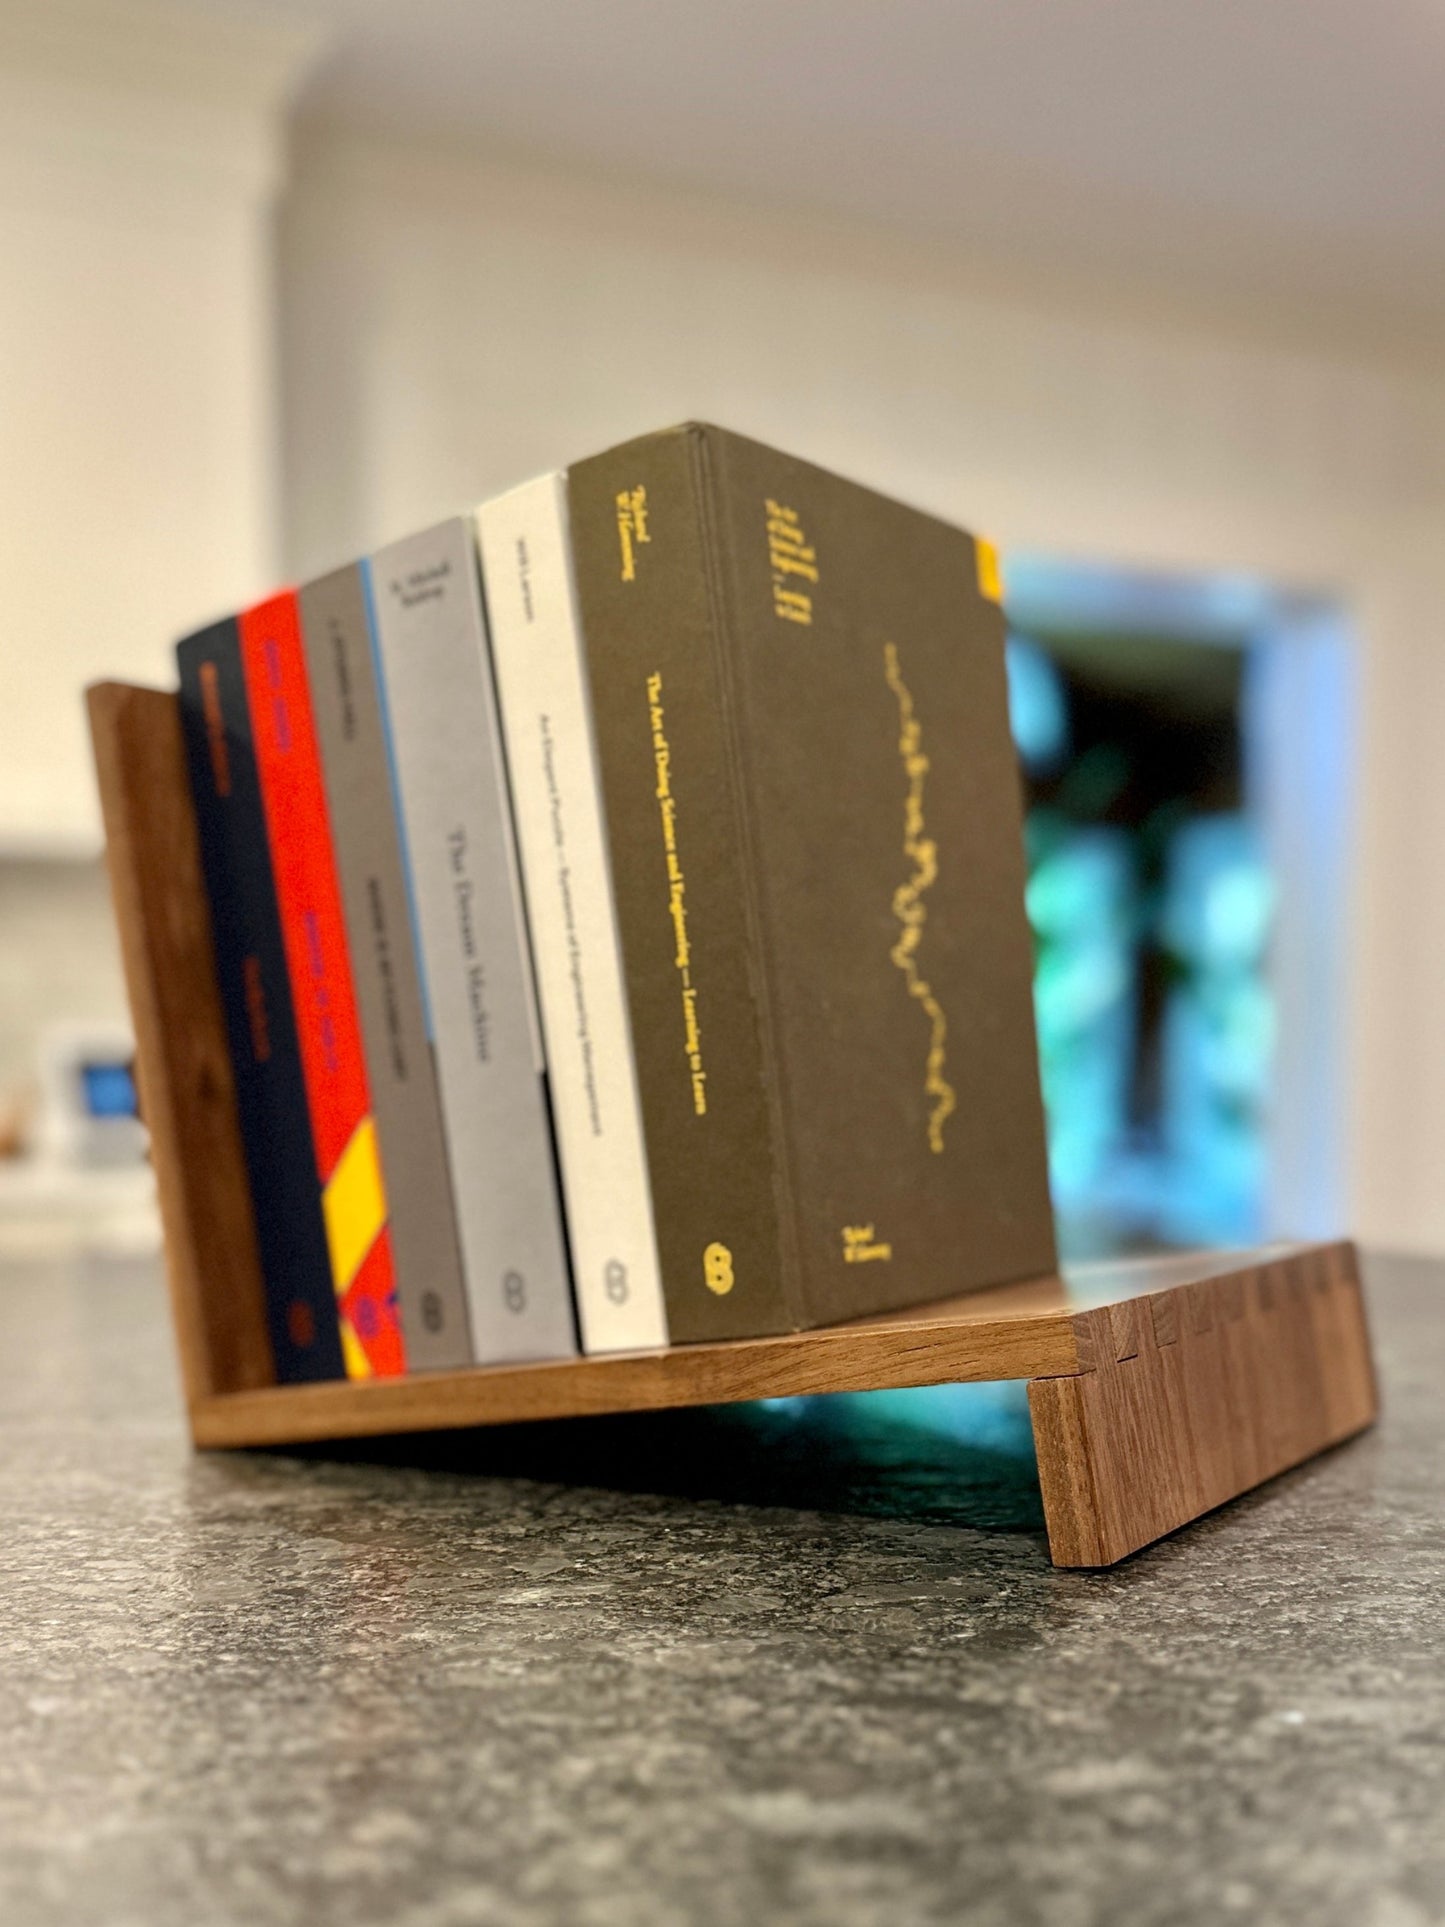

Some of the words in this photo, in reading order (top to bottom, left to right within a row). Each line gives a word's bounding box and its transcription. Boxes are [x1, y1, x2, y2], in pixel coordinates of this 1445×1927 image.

[646, 670, 662, 704] The
[650, 705, 664, 731] Art
[653, 732, 669, 749] of
[655, 749, 671, 798] Doing
[661, 798, 677, 851] Science
[448, 824, 466, 875] The
[667, 852, 684, 882] and
[669, 882, 692, 968] Engineering
[682, 988, 701, 1055] Learning
[690, 1053, 701, 1071] to
[692, 1071, 706, 1116] Learn
